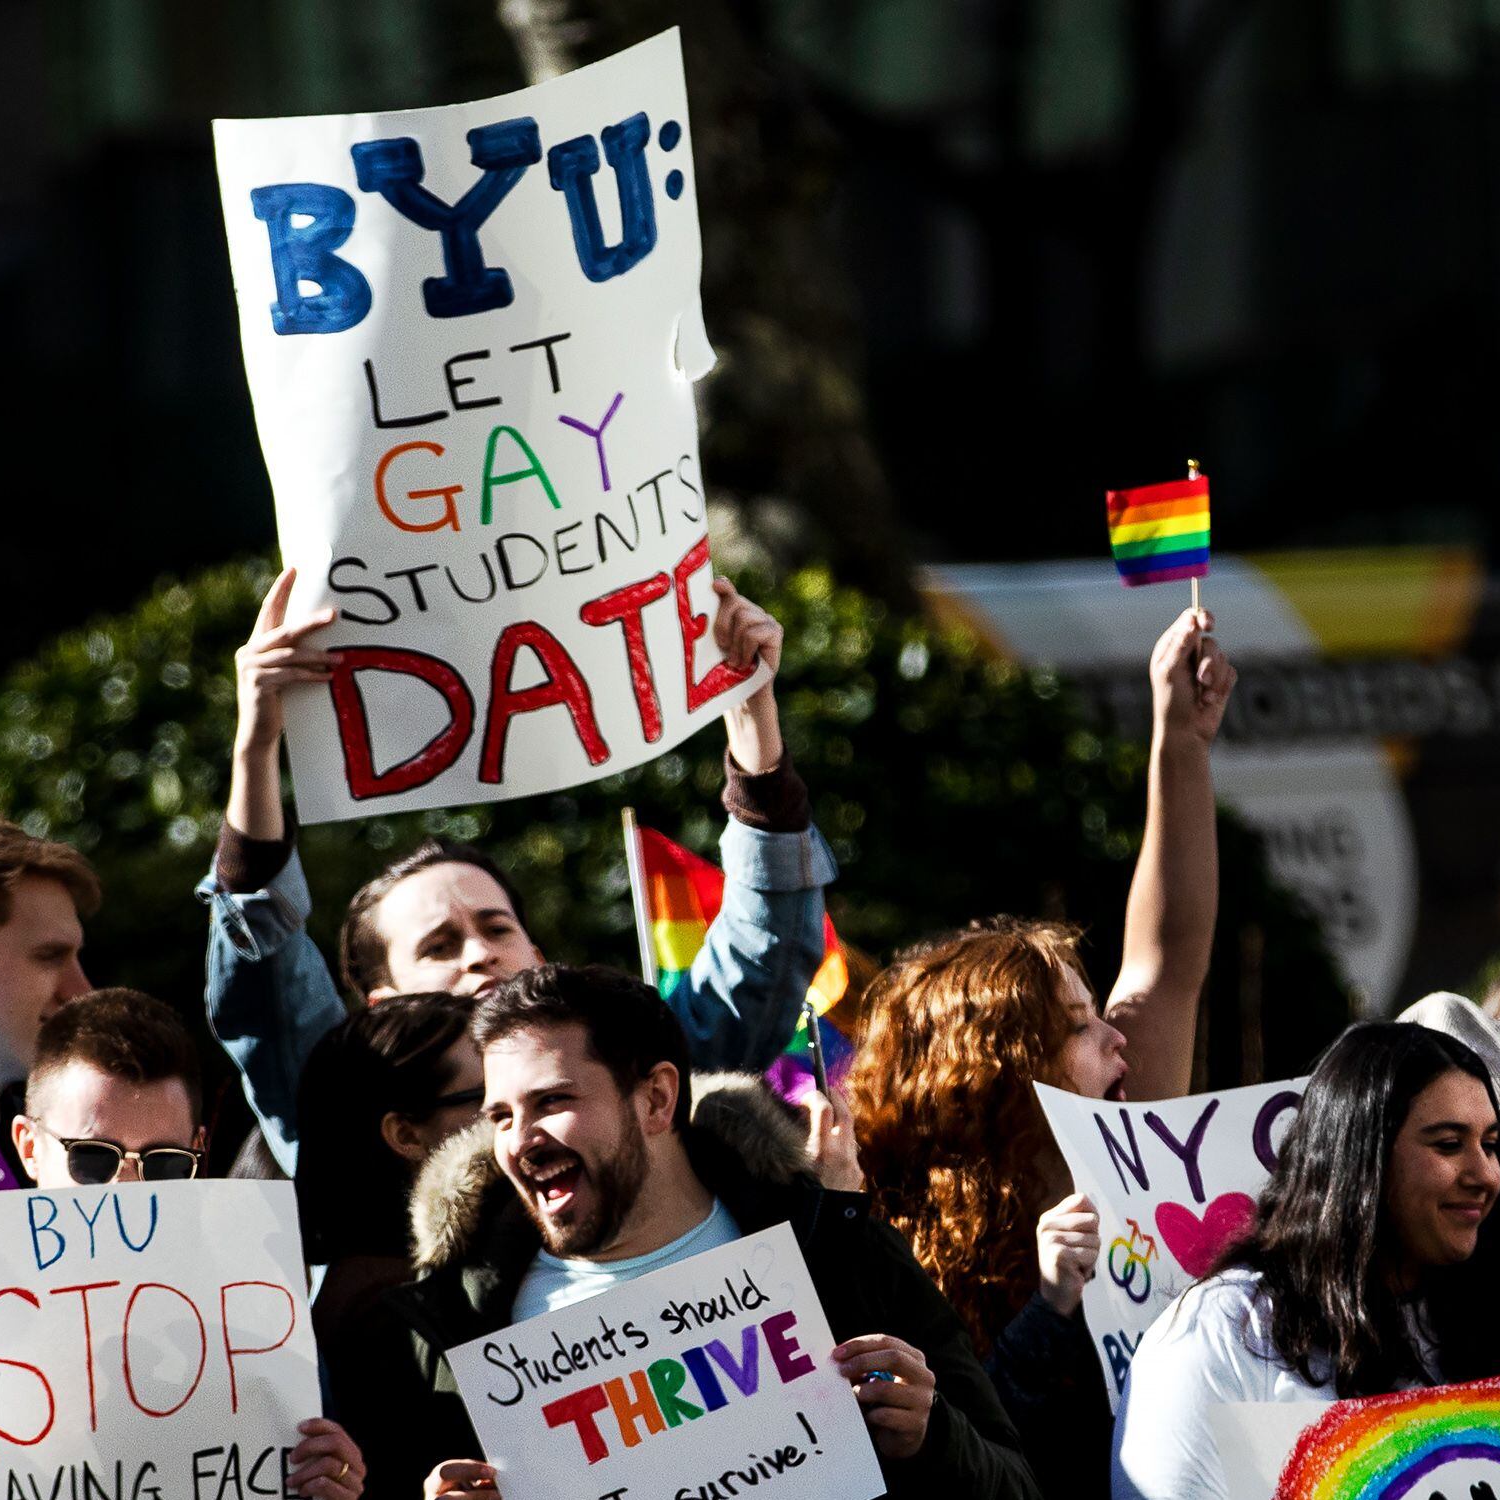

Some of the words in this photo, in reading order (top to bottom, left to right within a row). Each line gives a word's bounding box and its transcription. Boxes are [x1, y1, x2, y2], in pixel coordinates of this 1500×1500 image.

[251, 112, 686, 335] BYU:
[364, 332, 571, 429] LET
[375, 392, 623, 533] GAY
[329, 454, 707, 626] STUDENTS
[329, 535, 757, 800] DATE
[27, 1192, 159, 1270] BYU
[482, 1314, 650, 1407] Students
[659, 1268, 771, 1336] should
[541, 1310, 817, 1466] THRIVE
